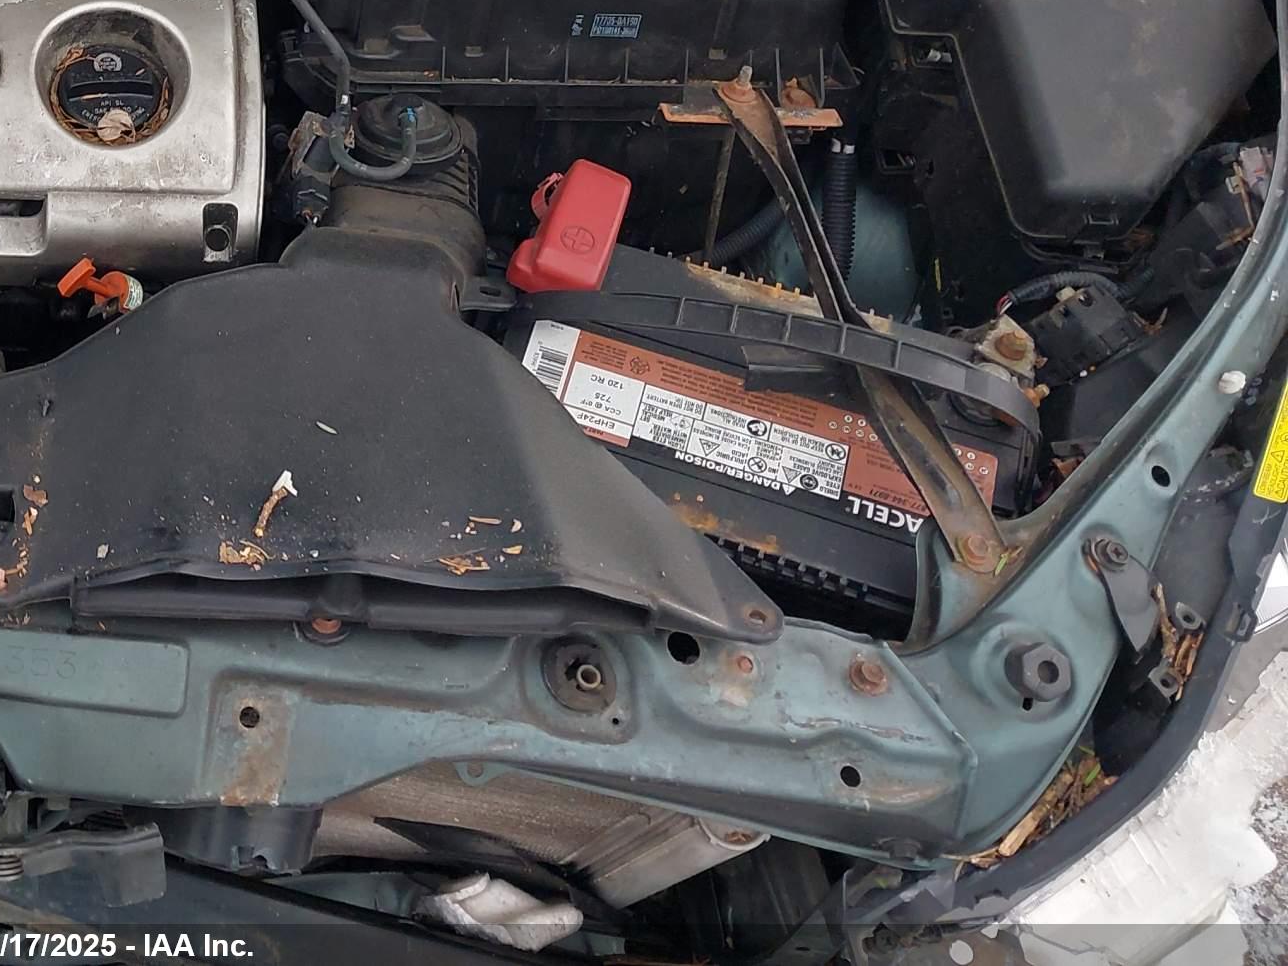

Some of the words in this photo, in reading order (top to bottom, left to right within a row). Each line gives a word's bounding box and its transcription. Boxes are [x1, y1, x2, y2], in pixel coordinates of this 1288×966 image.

[589, 373, 605, 384] RC
[606, 378, 624, 390] 120
[593, 391, 612, 402] 725
[603, 405, 621, 415] CCA
[576, 411, 615, 429] EHP24F
[672, 450, 782, 490] DANGER/POISON
